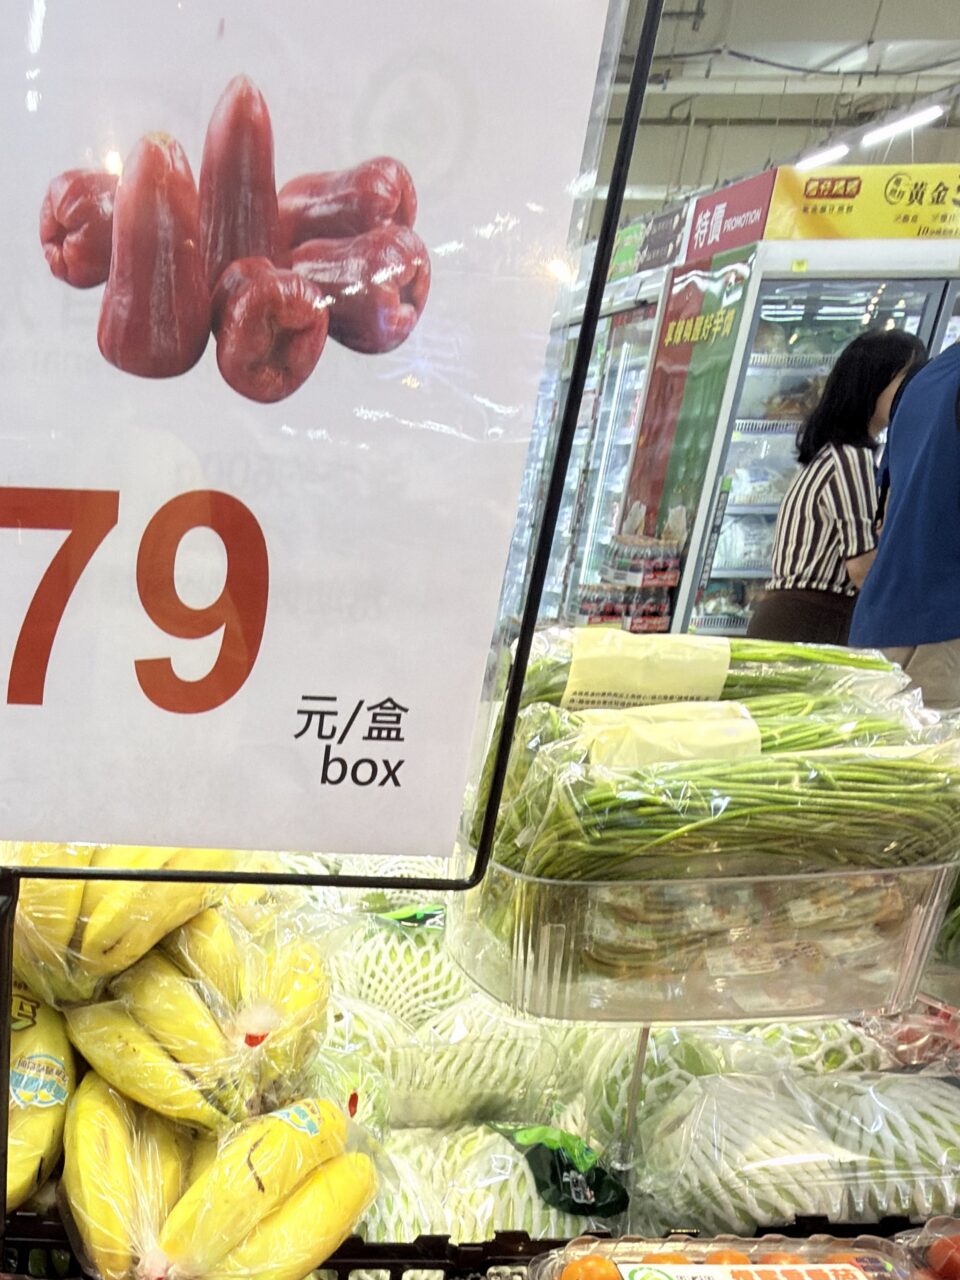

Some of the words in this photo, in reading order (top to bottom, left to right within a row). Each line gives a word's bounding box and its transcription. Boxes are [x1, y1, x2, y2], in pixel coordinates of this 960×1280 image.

[722, 208, 762, 233] PROMOTION
[294, 694, 408, 744] 元/盒
[320, 742, 405, 788] box
